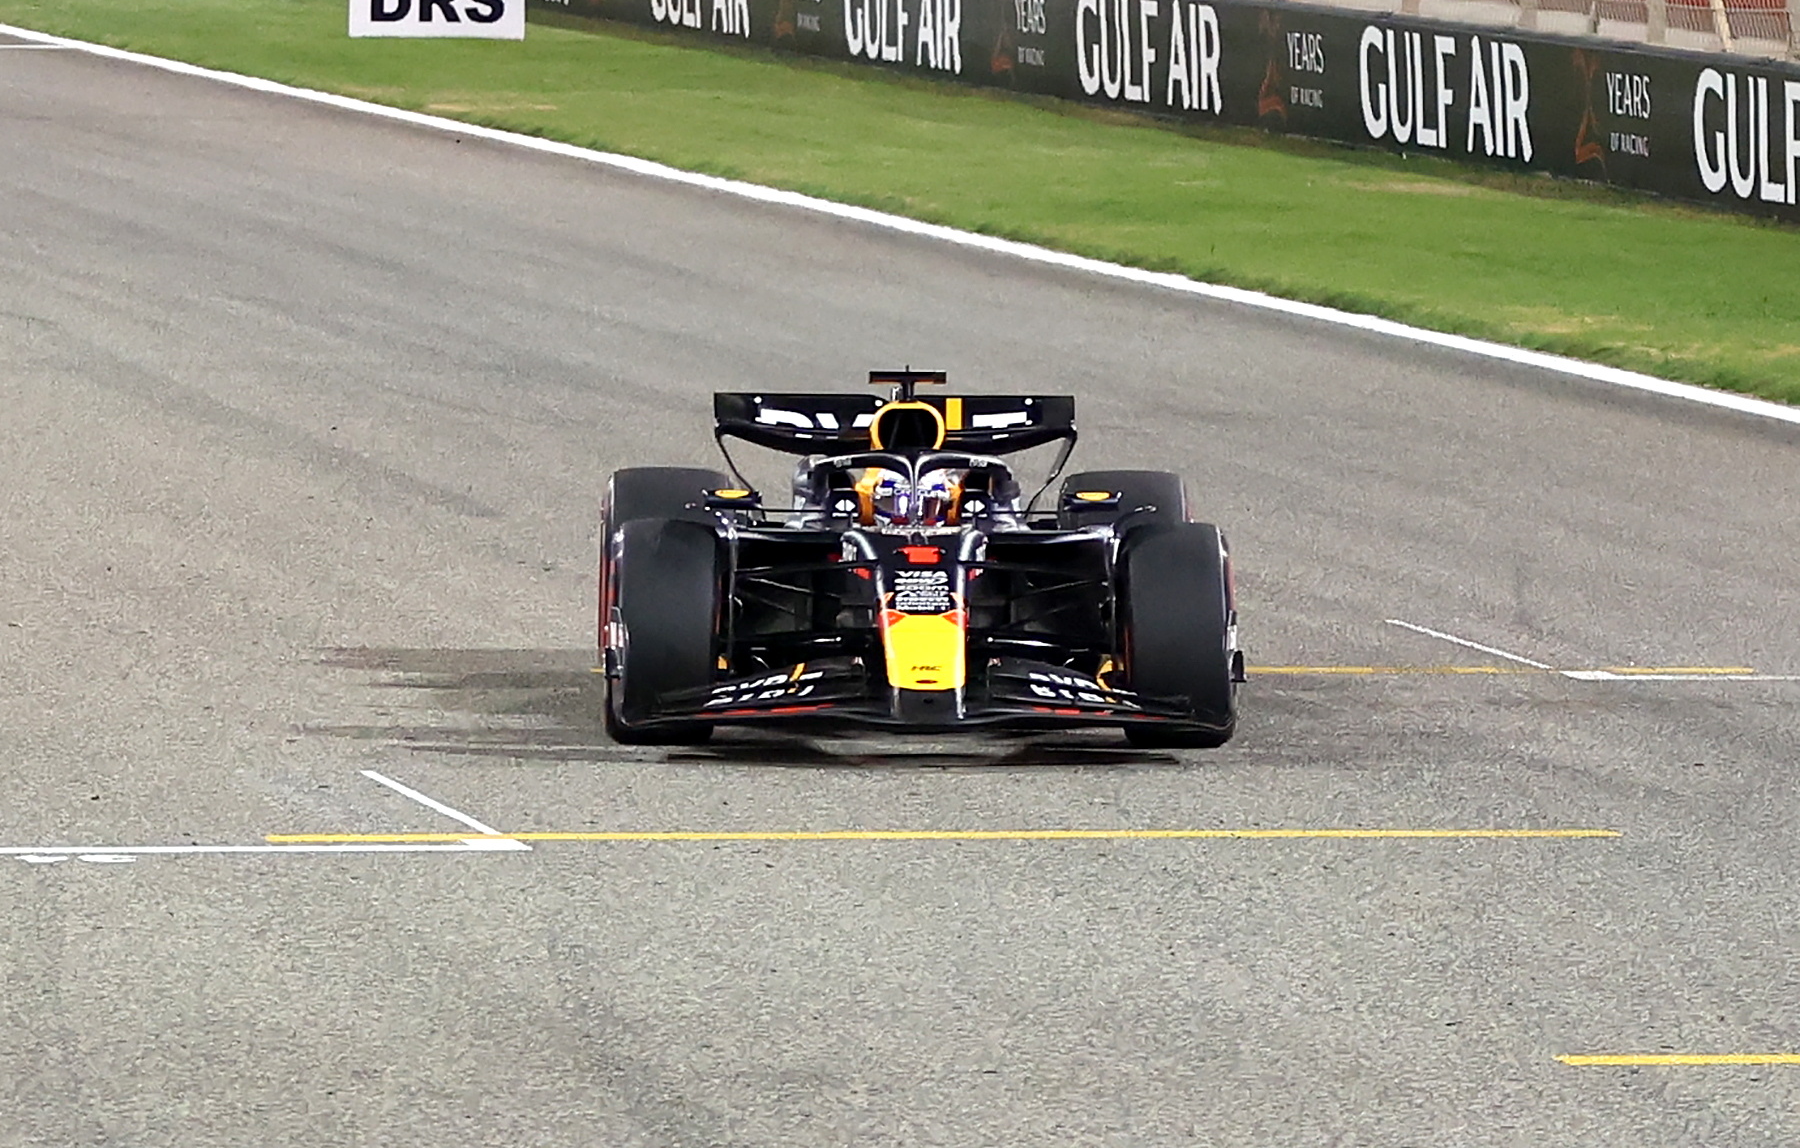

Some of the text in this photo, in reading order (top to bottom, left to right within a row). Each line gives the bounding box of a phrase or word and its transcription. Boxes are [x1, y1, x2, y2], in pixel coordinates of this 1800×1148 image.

[1286, 32, 1325, 73] YEARS
[1359, 24, 1533, 162] GULF AIR
[1606, 72, 1651, 119] YEARS
